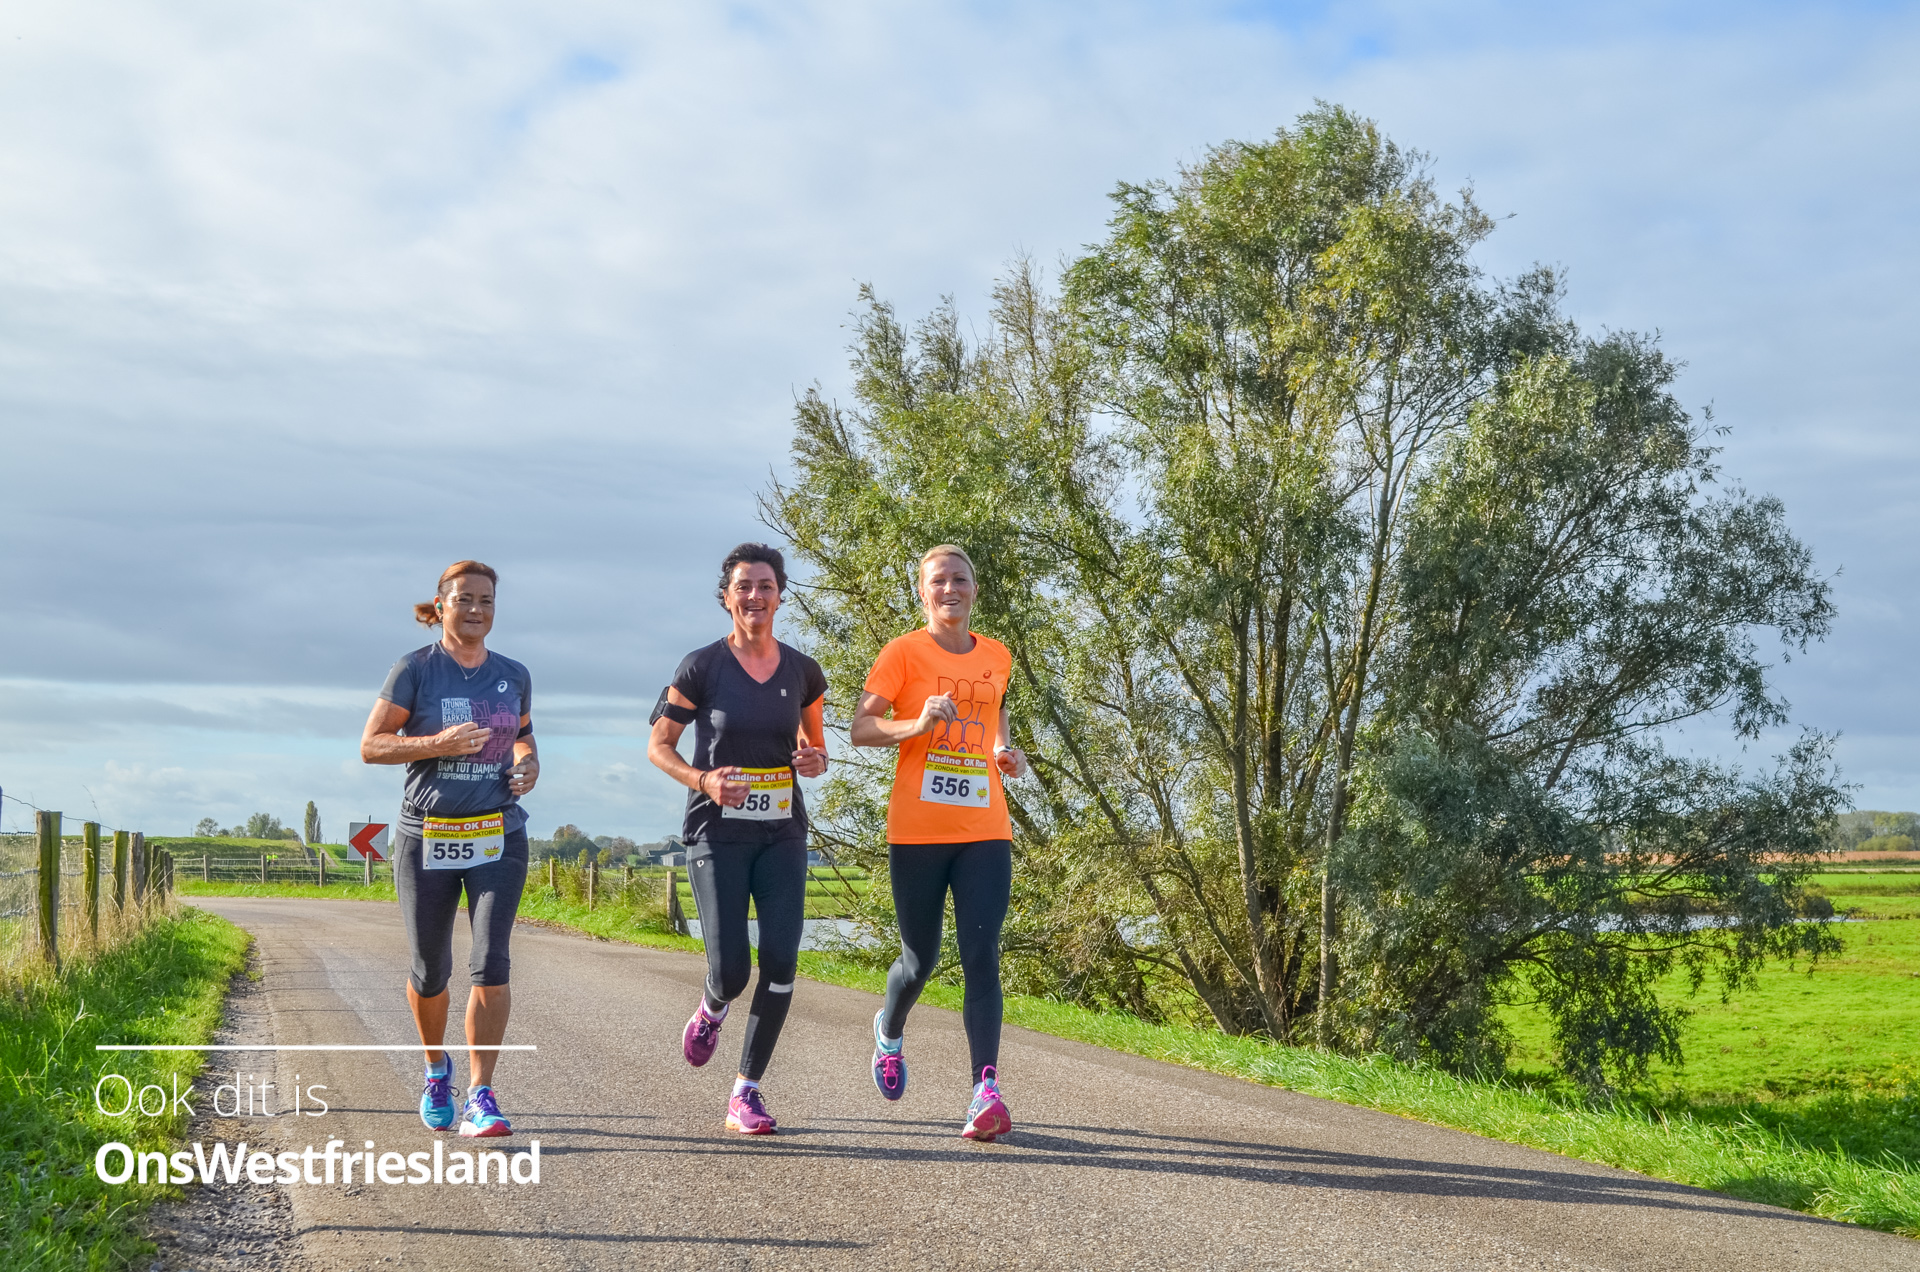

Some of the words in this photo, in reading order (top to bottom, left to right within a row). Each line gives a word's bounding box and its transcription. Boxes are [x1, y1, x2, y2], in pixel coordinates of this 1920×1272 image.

[443, 714, 473, 722] BARKPAD
[927, 753, 961, 766] Nadine
[964, 758, 975, 767] OK
[975, 760, 987, 768] Run
[437, 760, 455, 773] DAM
[456, 762, 472, 773] TOT
[934, 765, 959, 773] ZONDAG
[442, 772, 471, 780] SEPTEMBER
[727, 773, 761, 782] Nadine
[763, 774, 777, 782] OK
[777, 772, 791, 780] Run
[770, 781, 791, 789] OKTOBER
[931, 775, 970, 798] 556
[424, 822, 461, 831] Nadine
[463, 822, 479, 831] OK
[481, 820, 501, 828] Run
[472, 829, 501, 837] OKTOBER
[433, 842, 475, 860] 555
